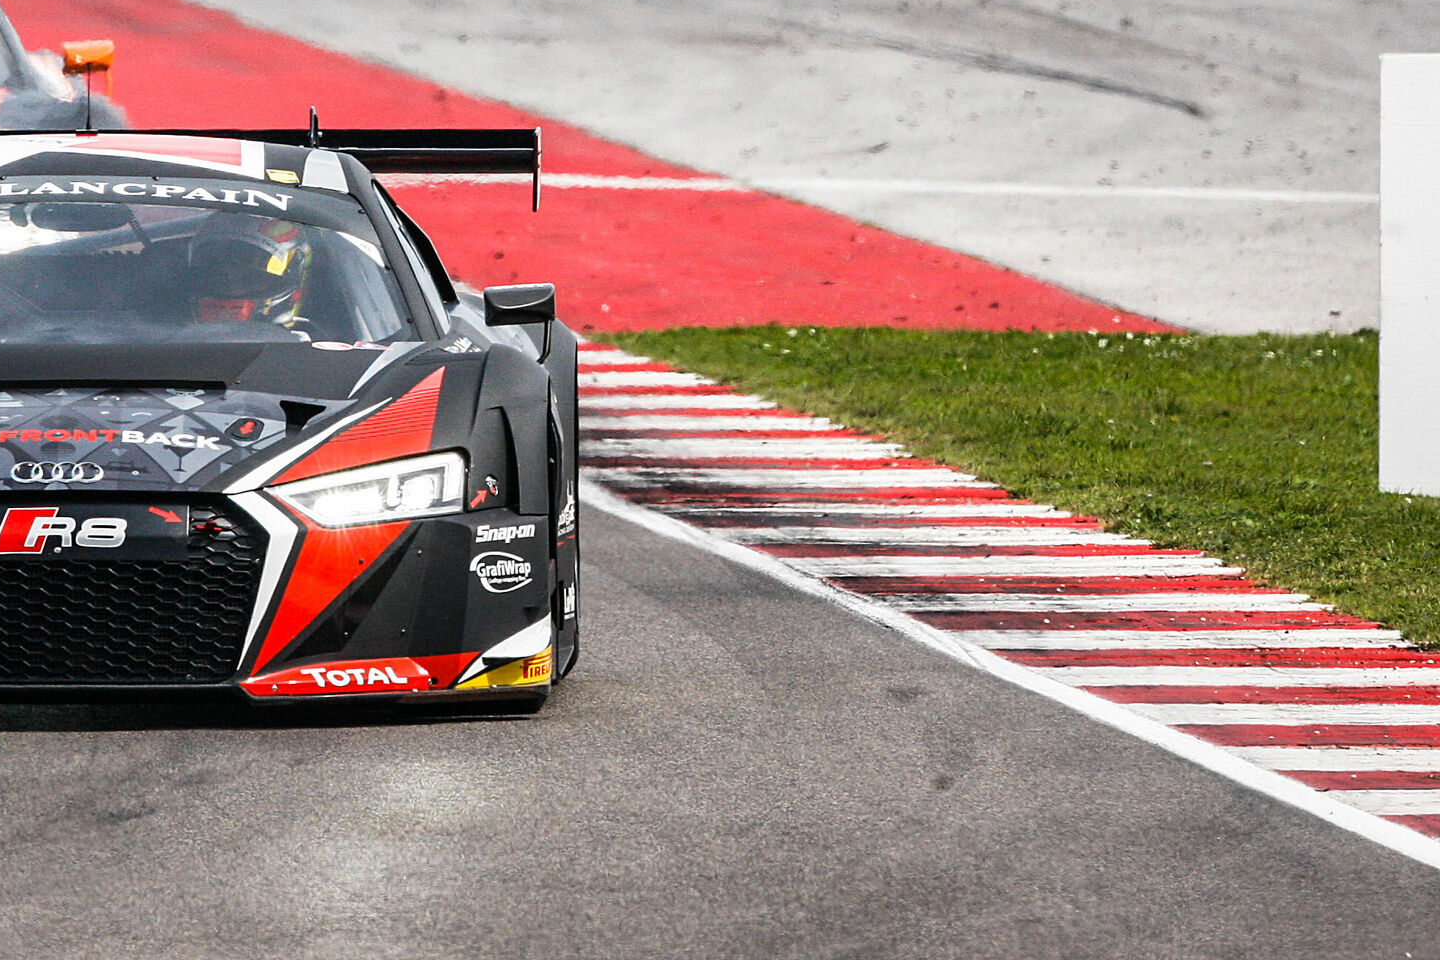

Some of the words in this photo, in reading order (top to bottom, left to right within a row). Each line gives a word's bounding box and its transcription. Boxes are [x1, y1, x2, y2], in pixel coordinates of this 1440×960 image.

[19, 514, 127, 549] R8
[475, 524, 536, 544] Snap-on
[476, 560, 532, 577] GrafiWrap
[301, 666, 408, 688] TOTAL
